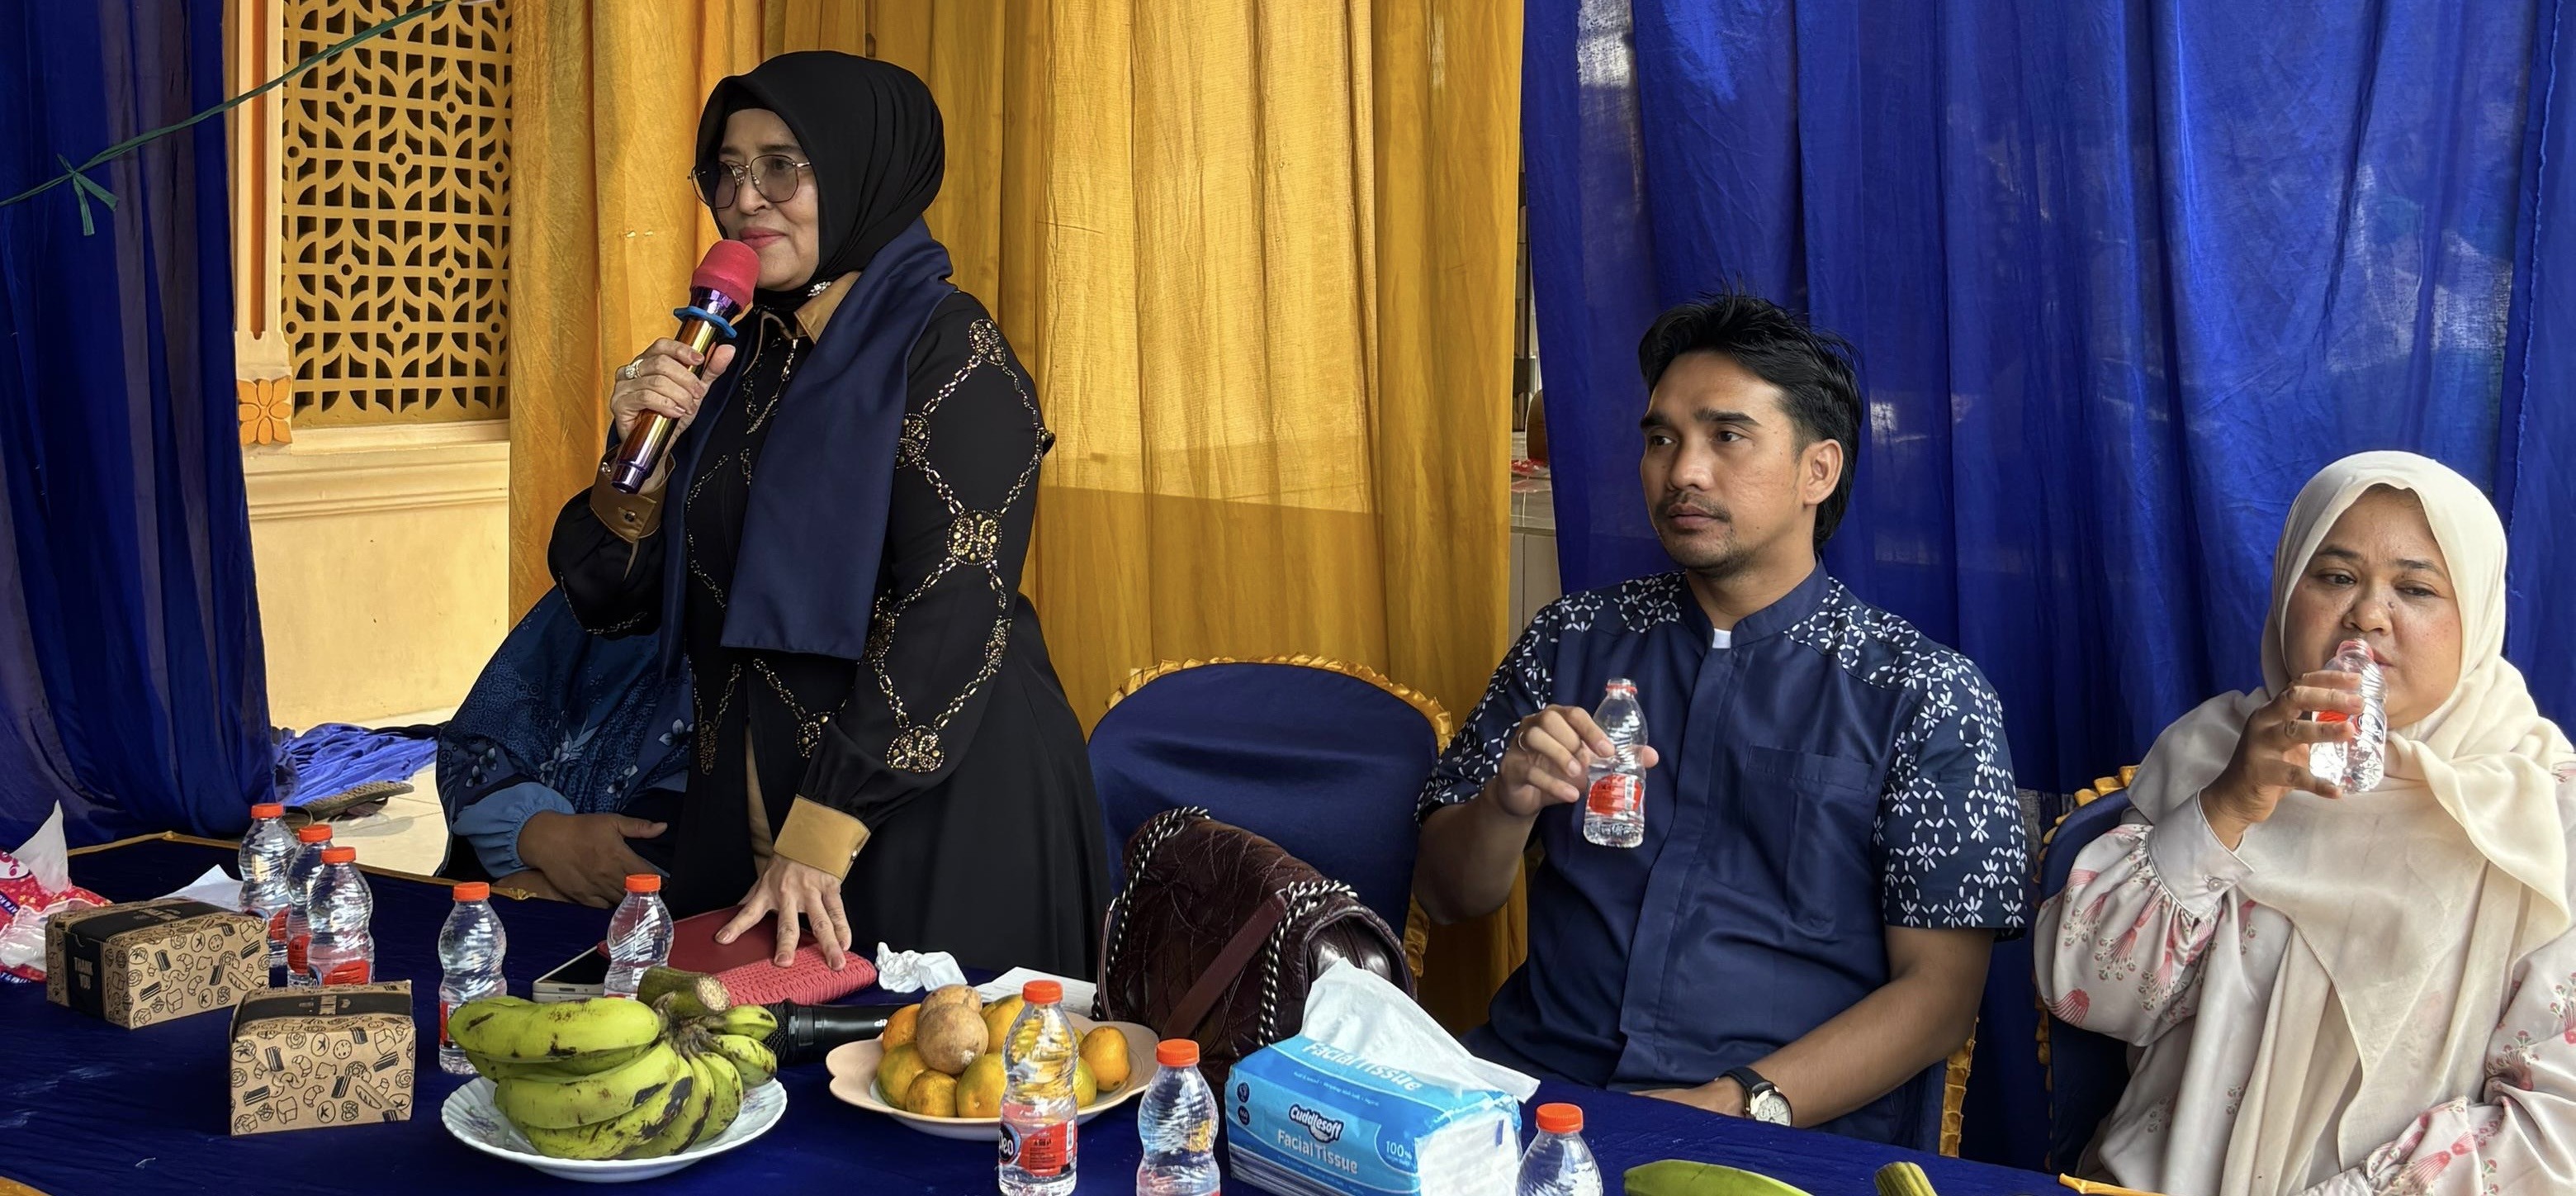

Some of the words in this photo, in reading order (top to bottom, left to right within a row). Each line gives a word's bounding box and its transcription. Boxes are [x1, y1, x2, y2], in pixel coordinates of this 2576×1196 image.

[1302, 1042, 1360, 1065] Facial
[1290, 1106, 1343, 1140] Cuddlesoft
[1278, 1129, 1314, 1156] Facial
[1316, 1145, 1358, 1175] Tissue
